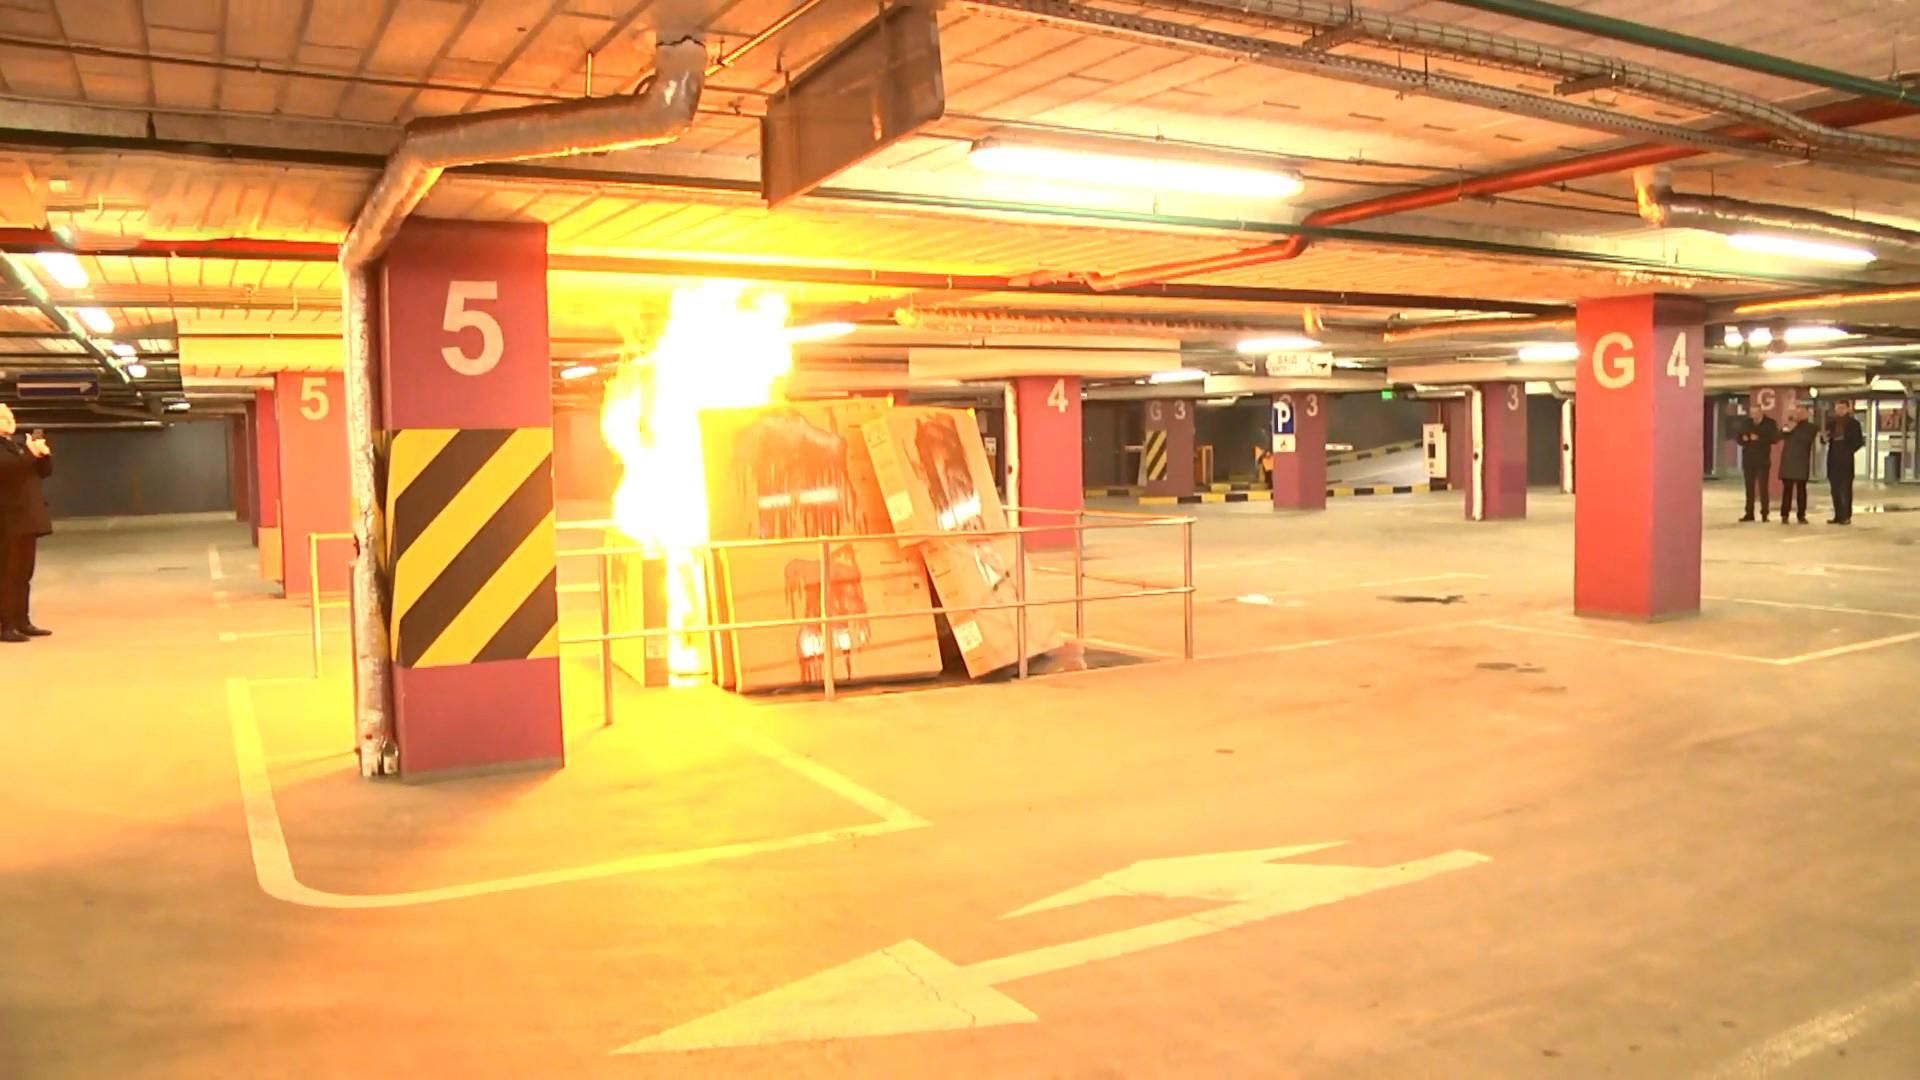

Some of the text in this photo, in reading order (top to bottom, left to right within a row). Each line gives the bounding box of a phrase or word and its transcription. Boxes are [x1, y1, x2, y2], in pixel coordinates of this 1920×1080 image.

[441, 280, 504, 376] 5
[1592, 332, 1635, 389] G
[1666, 331, 1690, 388] 4
[300, 377, 329, 420] 5
[1047, 378, 1069, 413] 4
[1174, 401, 1187, 420] 3
[1306, 394, 1319, 417] 3
[1507, 384, 1520, 411] 3
[1274, 401, 1291, 433] P
